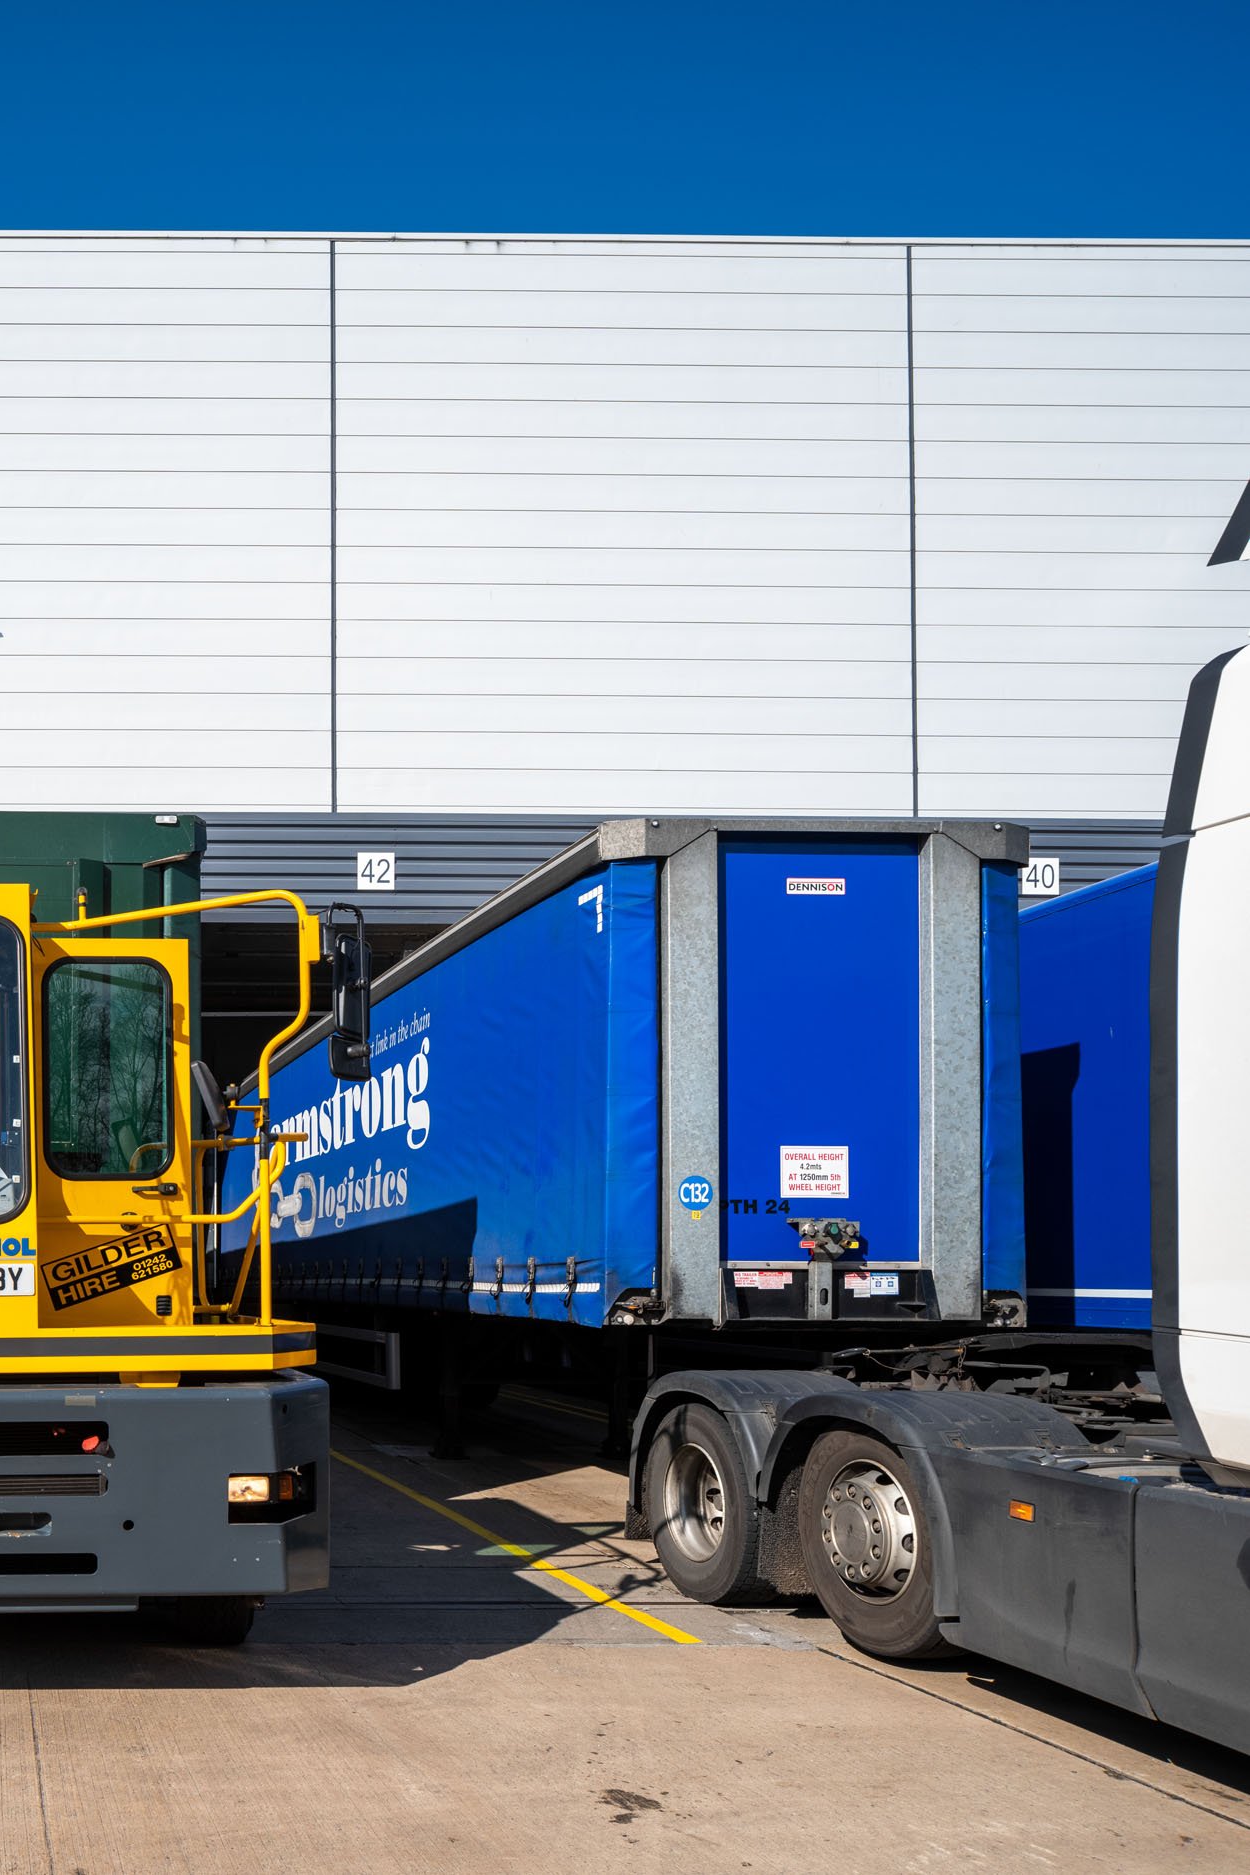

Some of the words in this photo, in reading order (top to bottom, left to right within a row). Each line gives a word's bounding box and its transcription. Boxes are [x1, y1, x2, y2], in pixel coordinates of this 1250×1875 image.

[361, 858, 390, 883] 42
[1026, 864, 1055, 888] 40
[788, 883, 843, 891] DENNISON
[375, 1029, 388, 1056] link
[398, 1019, 409, 1044] the
[410, 1007, 431, 1037] chain
[785, 1153, 816, 1161] OVERALL
[818, 1153, 844, 1161] HEIGHT
[788, 1173, 797, 1181] AT
[800, 1173, 829, 1181] 1250mm
[830, 1173, 841, 1181] 5th
[788, 1183, 813, 1191] WHEEL
[815, 1183, 841, 1191] HEIGHT
[317, 1158, 408, 1228] logistics
[680, 1183, 710, 1203] C132
[765, 1199, 790, 1214] 24
[51, 1230, 166, 1282] GILDER
[133, 1254, 167, 1271] 01242
[131, 1260, 174, 1281] 621580
[57, 1270, 121, 1305] HIRE
